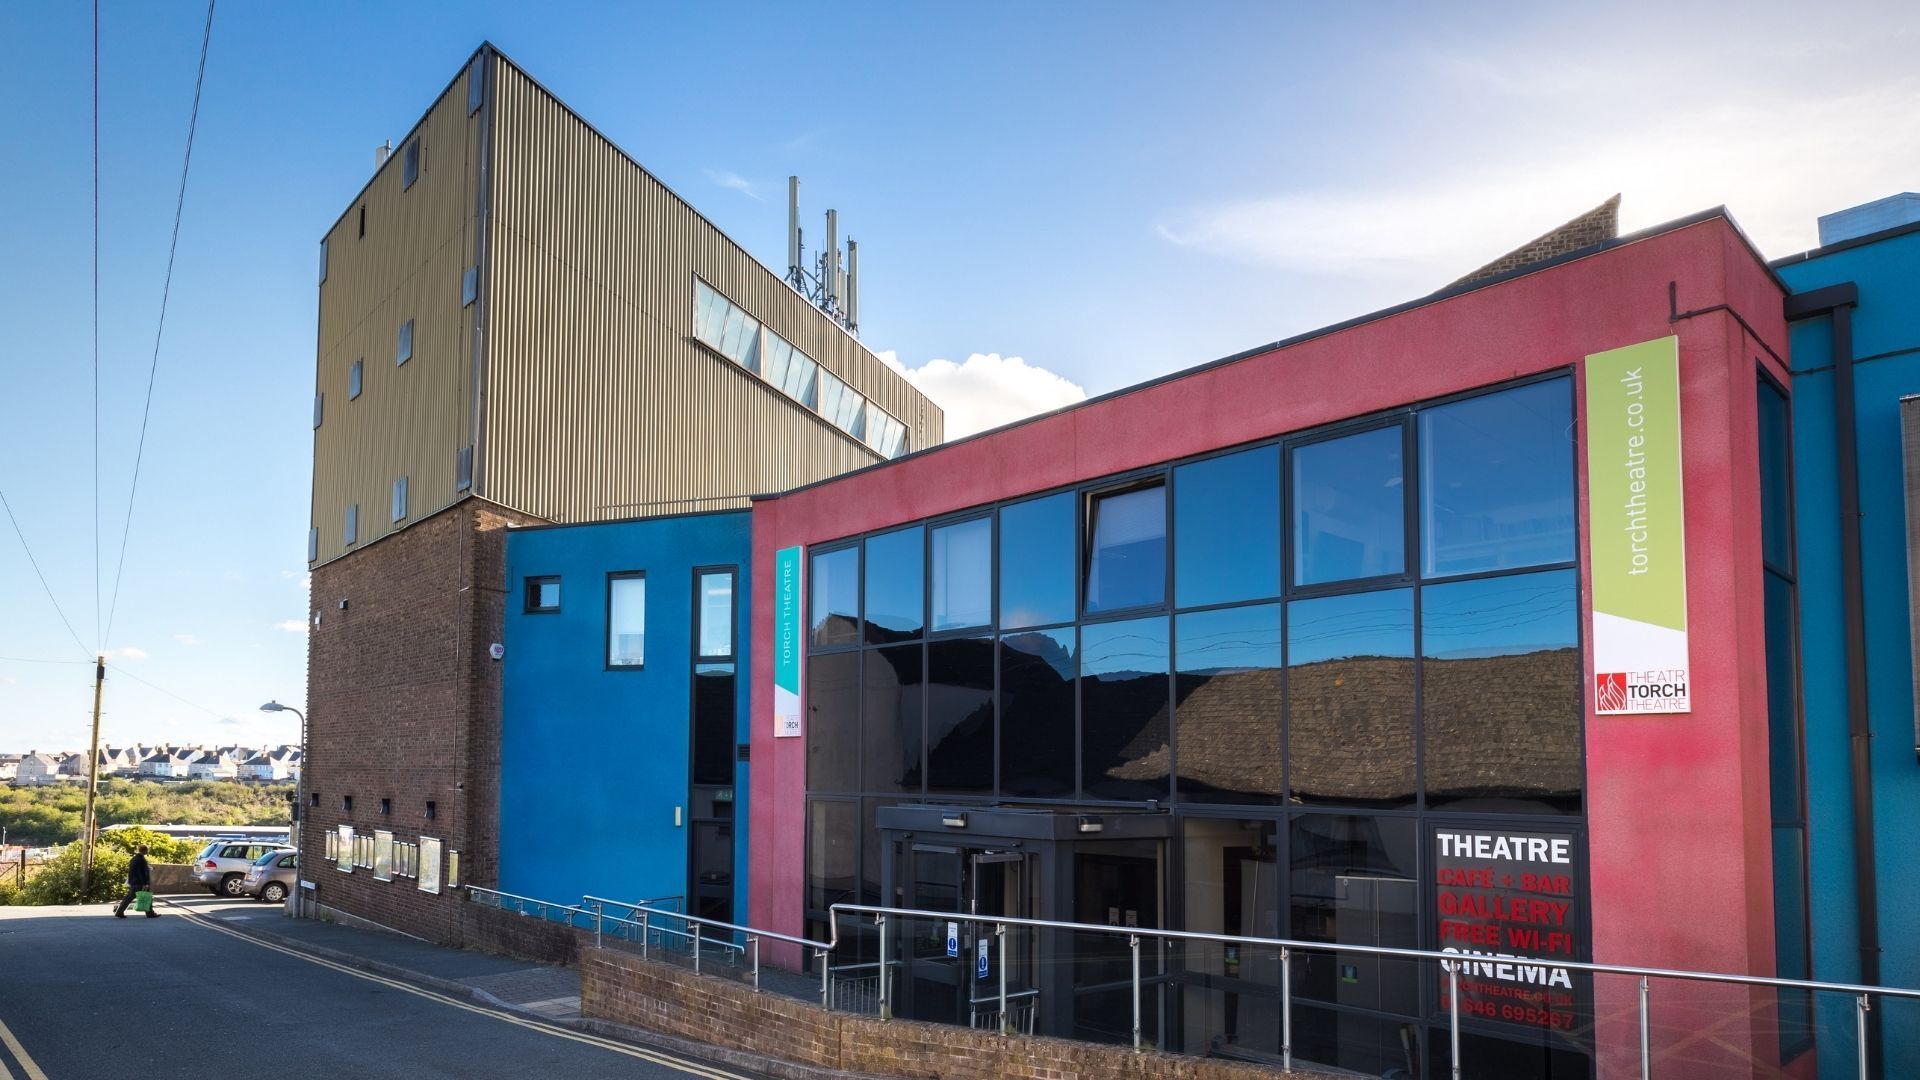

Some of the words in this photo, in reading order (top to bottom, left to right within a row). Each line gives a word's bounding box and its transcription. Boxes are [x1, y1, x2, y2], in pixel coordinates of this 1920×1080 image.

[1621, 366, 1648, 576] torchtheatre.co.uk
[783, 560, 792, 619] THEATRE
[783, 622, 791, 666] TORCH
[1627, 669, 1686, 684] THEATR
[1628, 683, 1686, 698] TORCH
[1628, 698, 1687, 710] THEATRE
[1437, 833, 1570, 864] THEATRE
[1438, 866, 1495, 888] CAFÉ
[1521, 873, 1570, 895] BAR
[1439, 891, 1569, 926] GALLERY
[1440, 920, 1500, 945] FREE
[1508, 927, 1572, 954] WI-FI
[1440, 947, 1573, 989] CINEMA
[1440, 993, 1496, 1017] 0646
[1502, 1004, 1574, 1029] 695267
